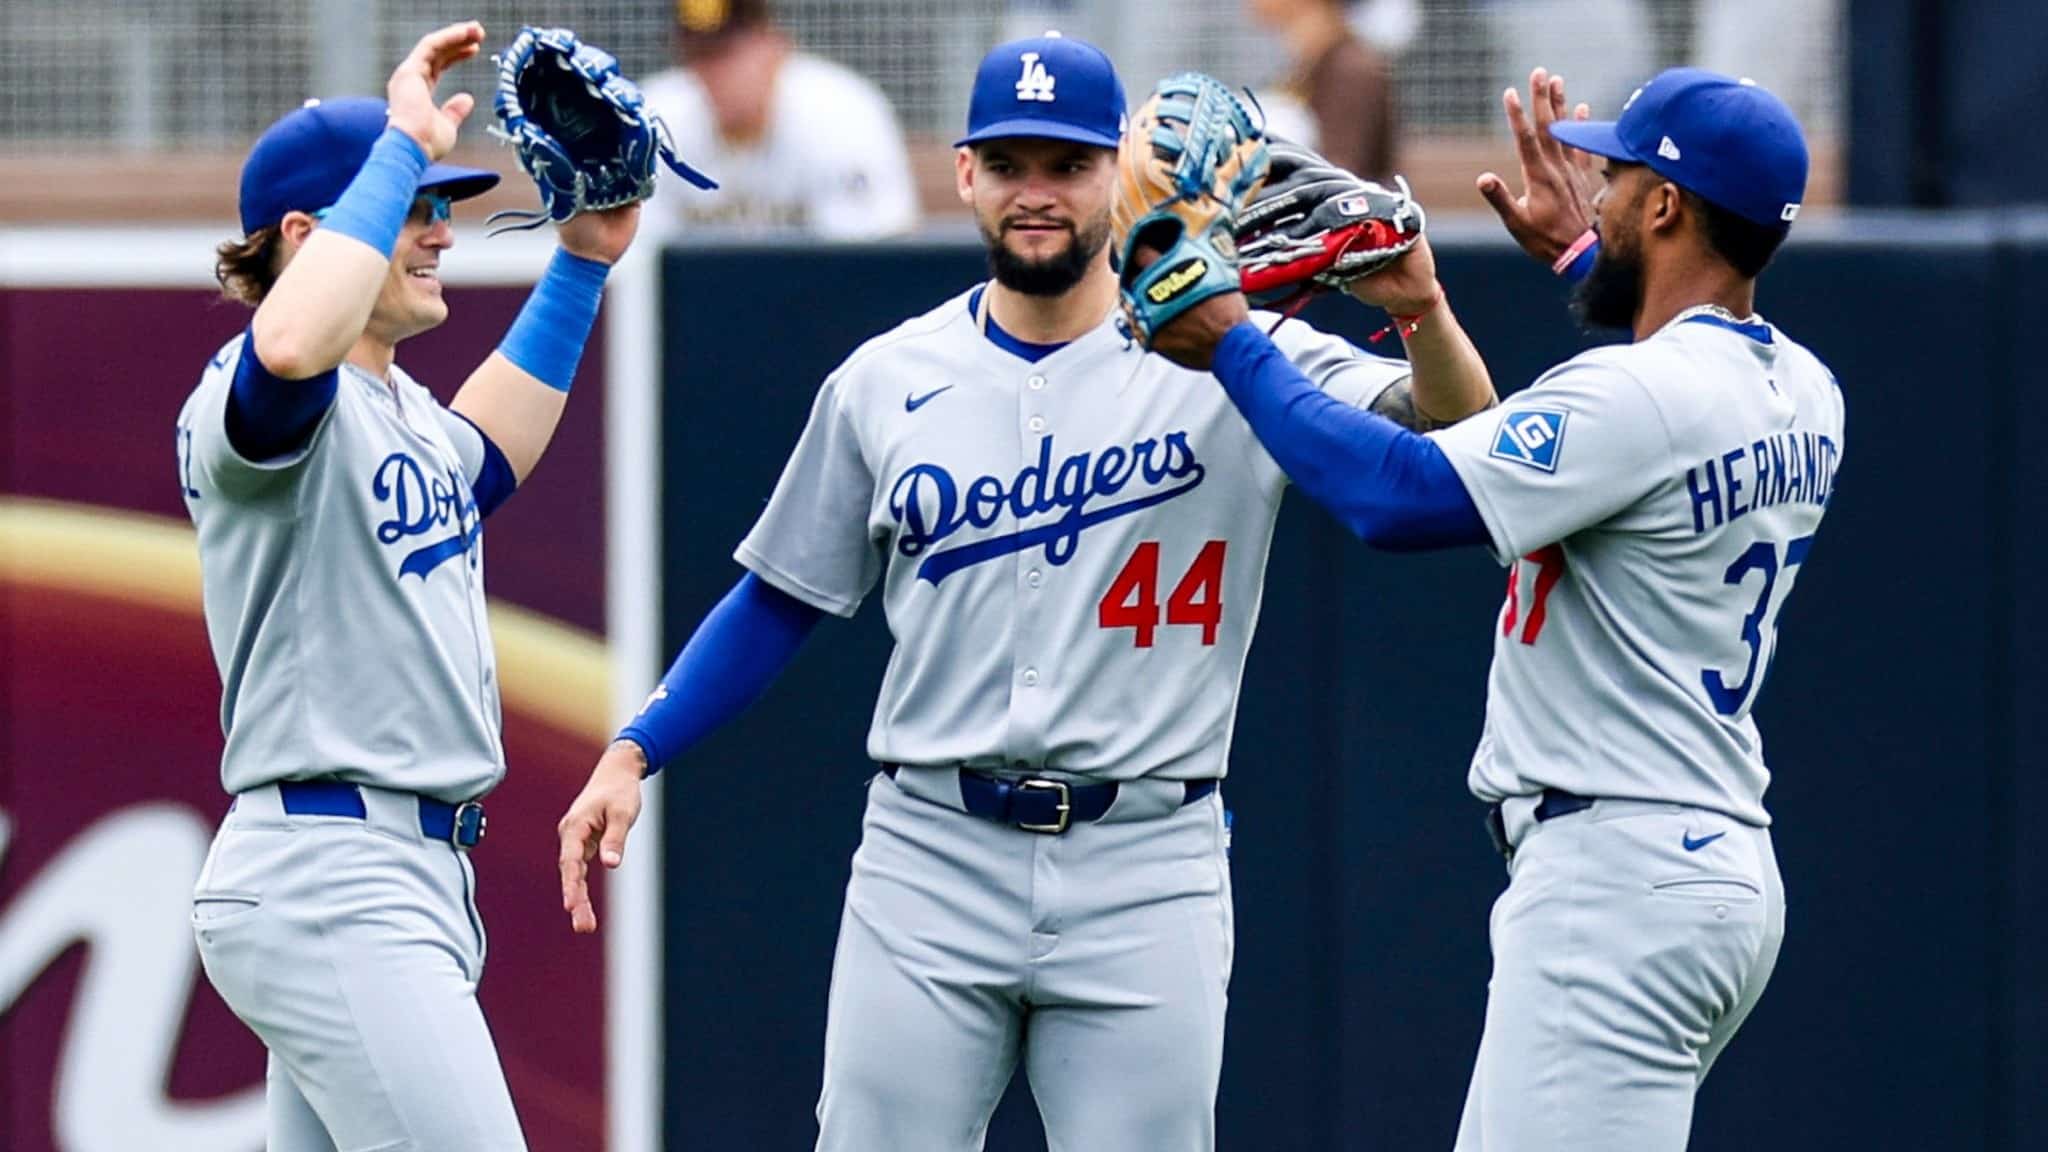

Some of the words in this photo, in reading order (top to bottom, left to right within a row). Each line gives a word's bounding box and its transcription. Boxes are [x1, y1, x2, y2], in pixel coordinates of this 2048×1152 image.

[1015, 52, 1055, 101] LA
[890, 430, 1205, 568] Dodgers
[1686, 431, 1837, 533] HERNAND
[1098, 540, 1228, 648] 44
